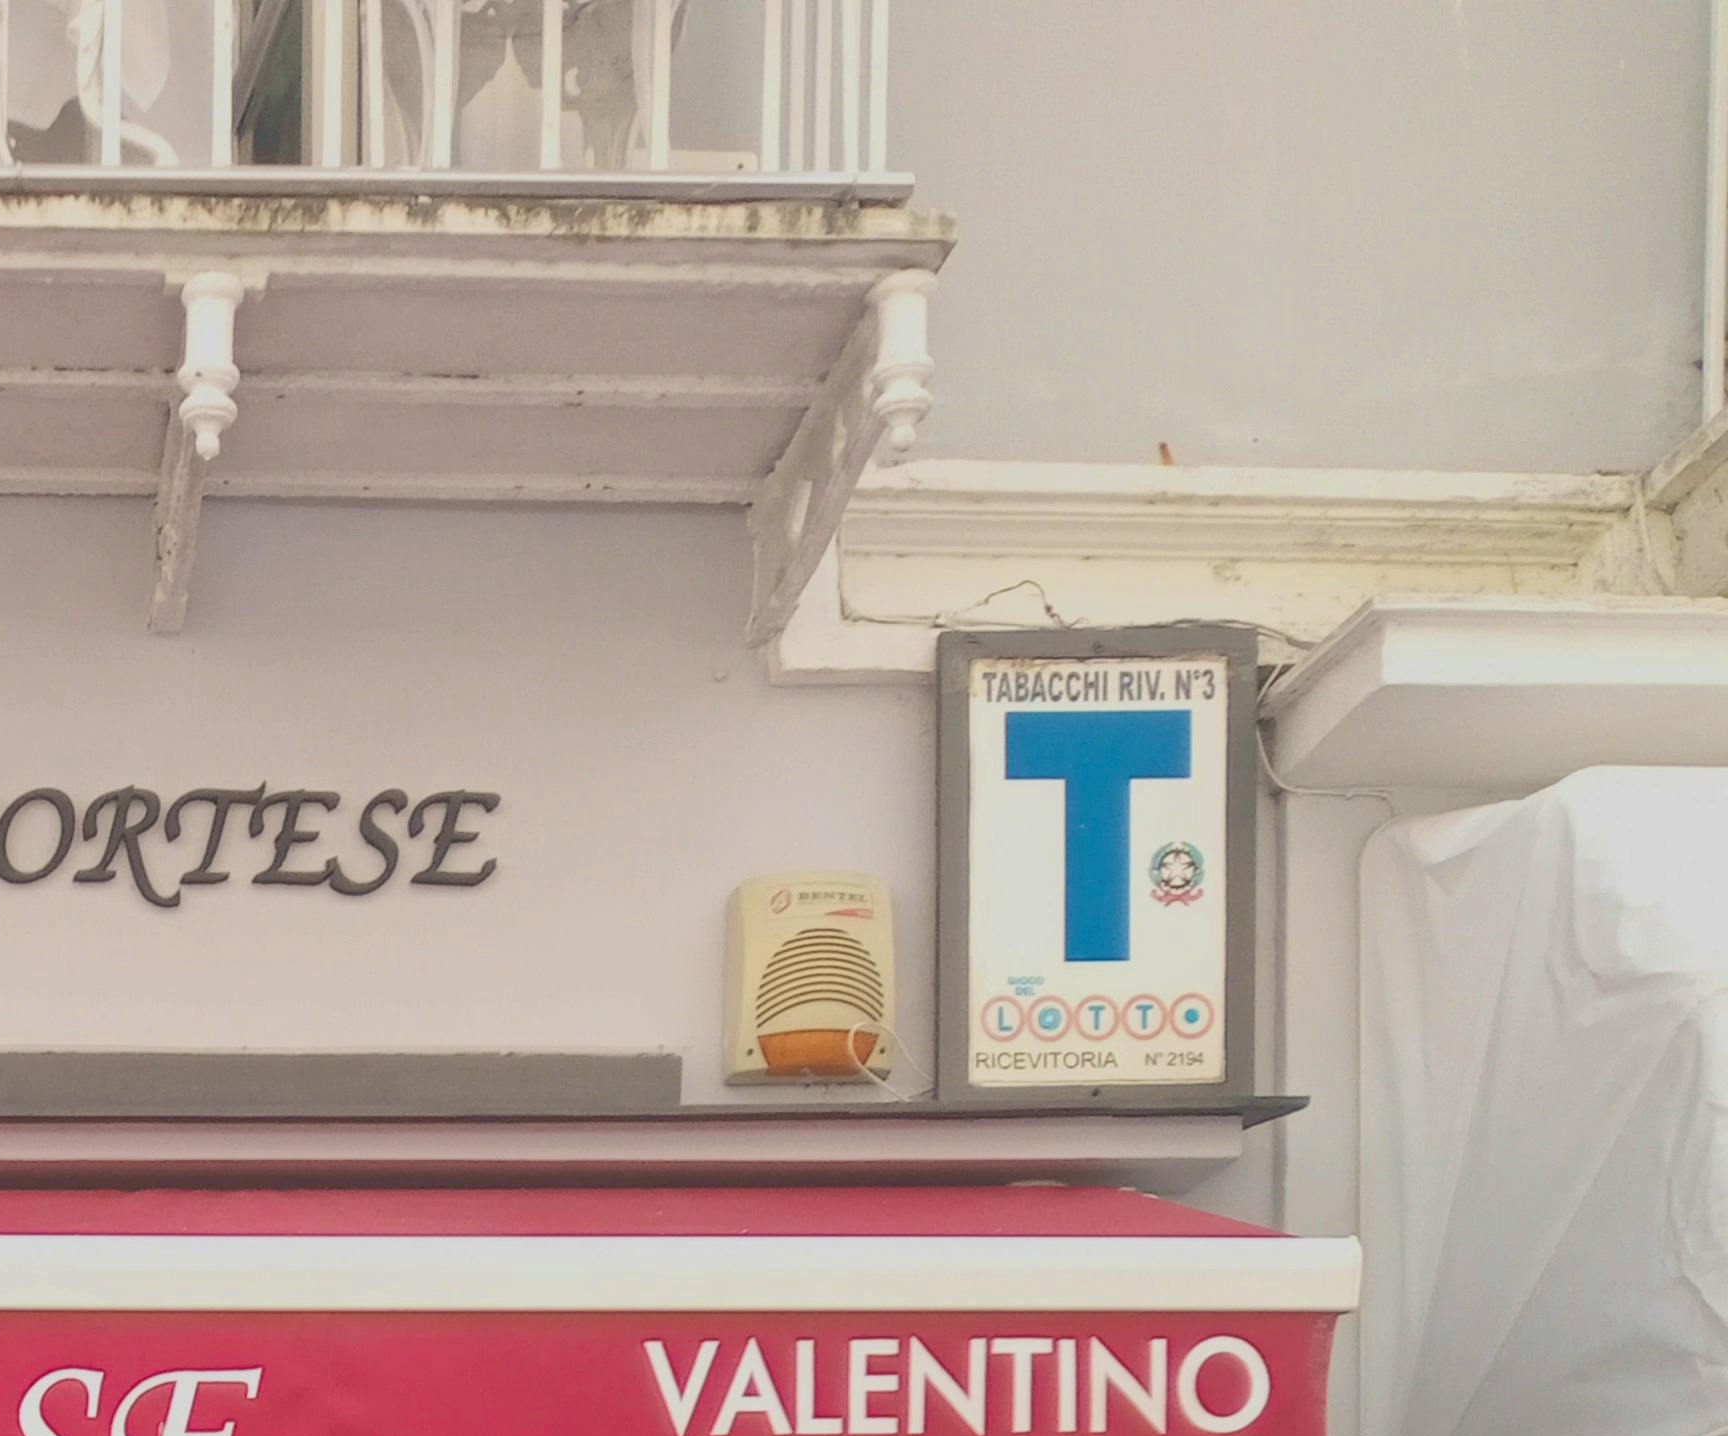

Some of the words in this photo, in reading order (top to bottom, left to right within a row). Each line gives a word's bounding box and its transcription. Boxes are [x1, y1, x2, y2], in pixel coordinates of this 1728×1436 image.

[981, 669, 1109, 702] TABACCHI
[1118, 669, 1165, 701] RIV.
[1004, 709, 1191, 962] T
[975, 1051, 1119, 1070] RICEVITORIA
[1167, 1051, 1205, 1066] 2194
